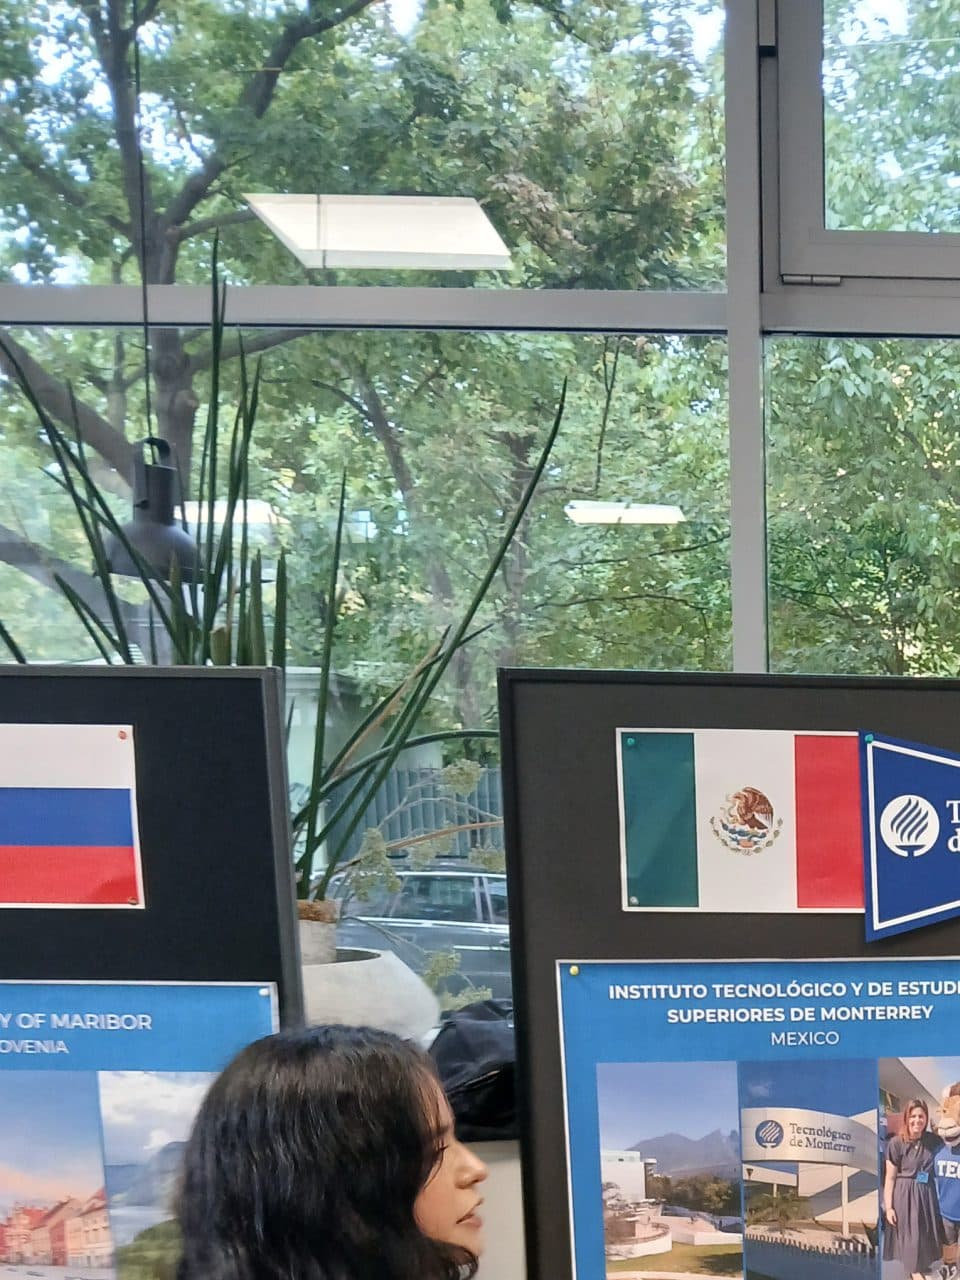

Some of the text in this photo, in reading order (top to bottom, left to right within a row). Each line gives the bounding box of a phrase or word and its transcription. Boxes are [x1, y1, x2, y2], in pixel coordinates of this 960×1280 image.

[608, 983, 707, 1000] INSTITUTO
[712, 979, 846, 998] TECNOLÓGICO
[851, 981, 864, 996] Y
[868, 981, 894, 996] DE
[16, 1013, 46, 1029] OF
[51, 1013, 152, 1030] MARIBOR
[667, 1004, 934, 1024] SUPERIORES DE MONTERREY
[770, 1031, 840, 1047] MEXICO
[789, 1122, 852, 1141] Tecnológico
[789, 1134, 803, 1148] de
